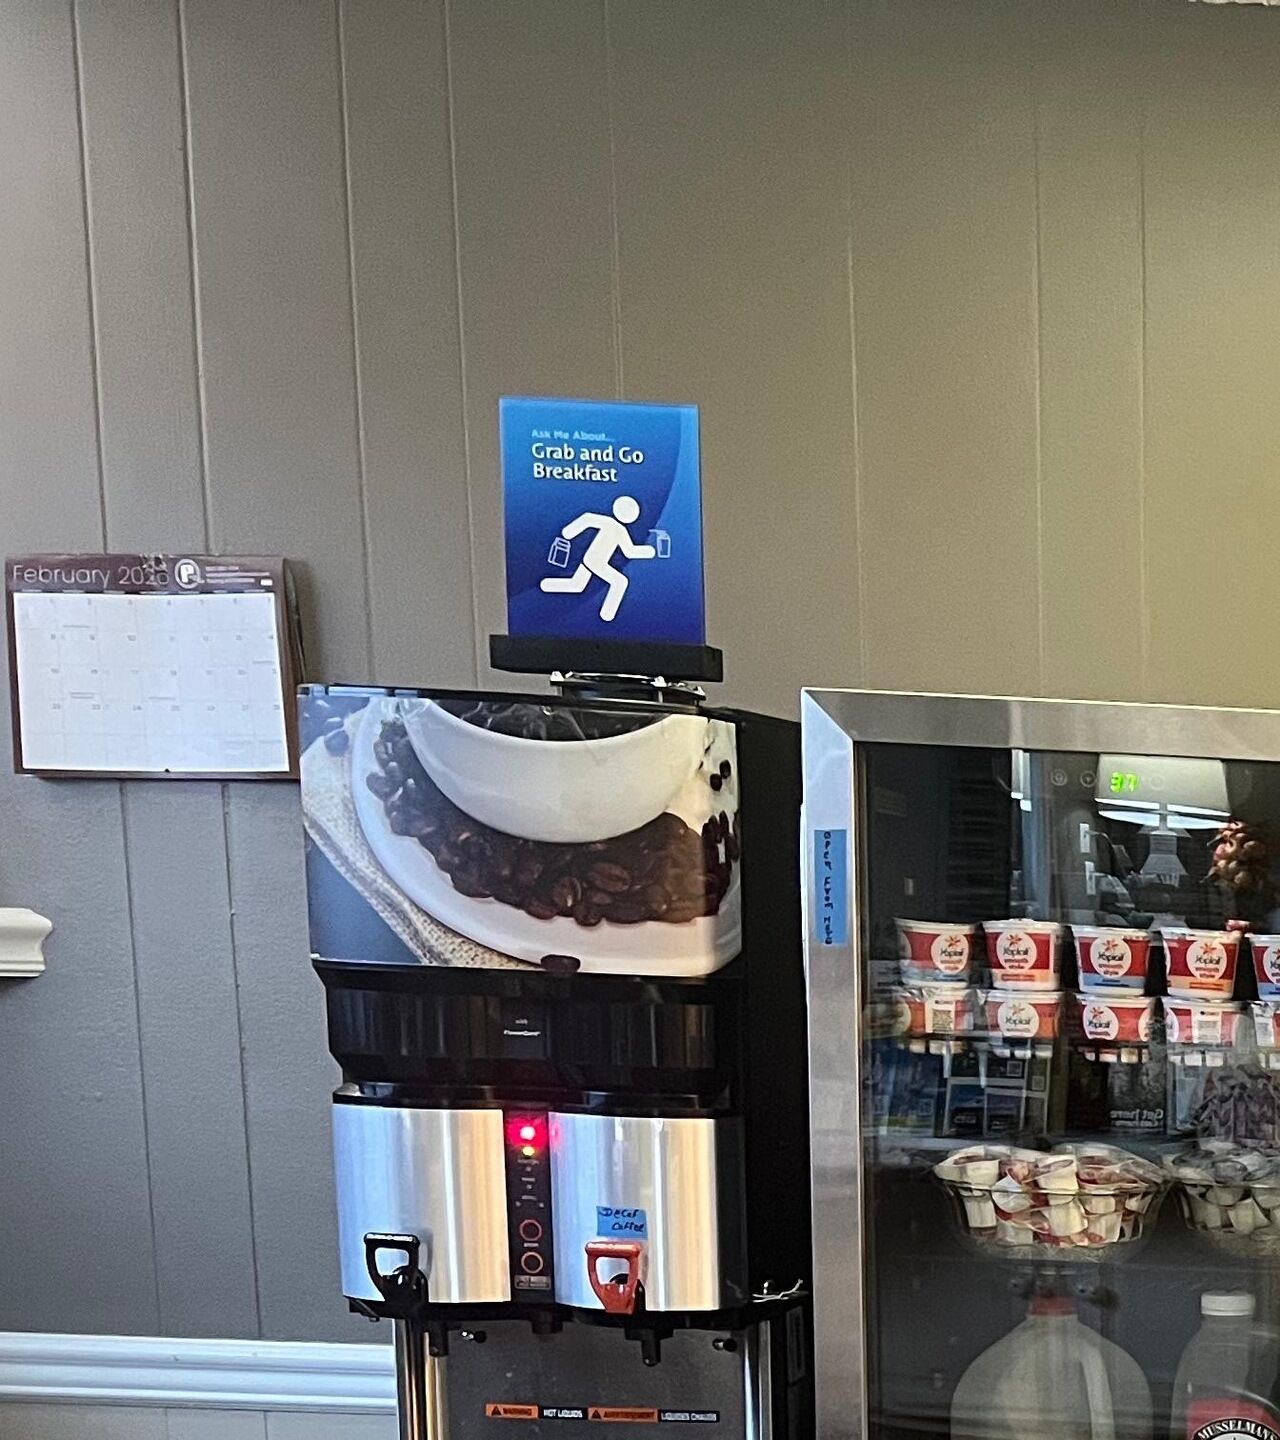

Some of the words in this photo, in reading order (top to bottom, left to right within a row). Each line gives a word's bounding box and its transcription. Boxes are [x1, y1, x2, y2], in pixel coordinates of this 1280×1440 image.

[531, 429, 550, 438] Ask
[553, 430, 570, 440] Me
[531, 442, 575, 459] Grab
[579, 445, 614, 462] and
[618, 447, 644, 464] Go
[532, 462, 618, 483] Breakfast
[13, 564, 111, 588] February
[1098, 951, 1125, 962] Yoplait
[1087, 1018, 1111, 1030] Yoplait
[544, 1408, 556, 1417] HOT
